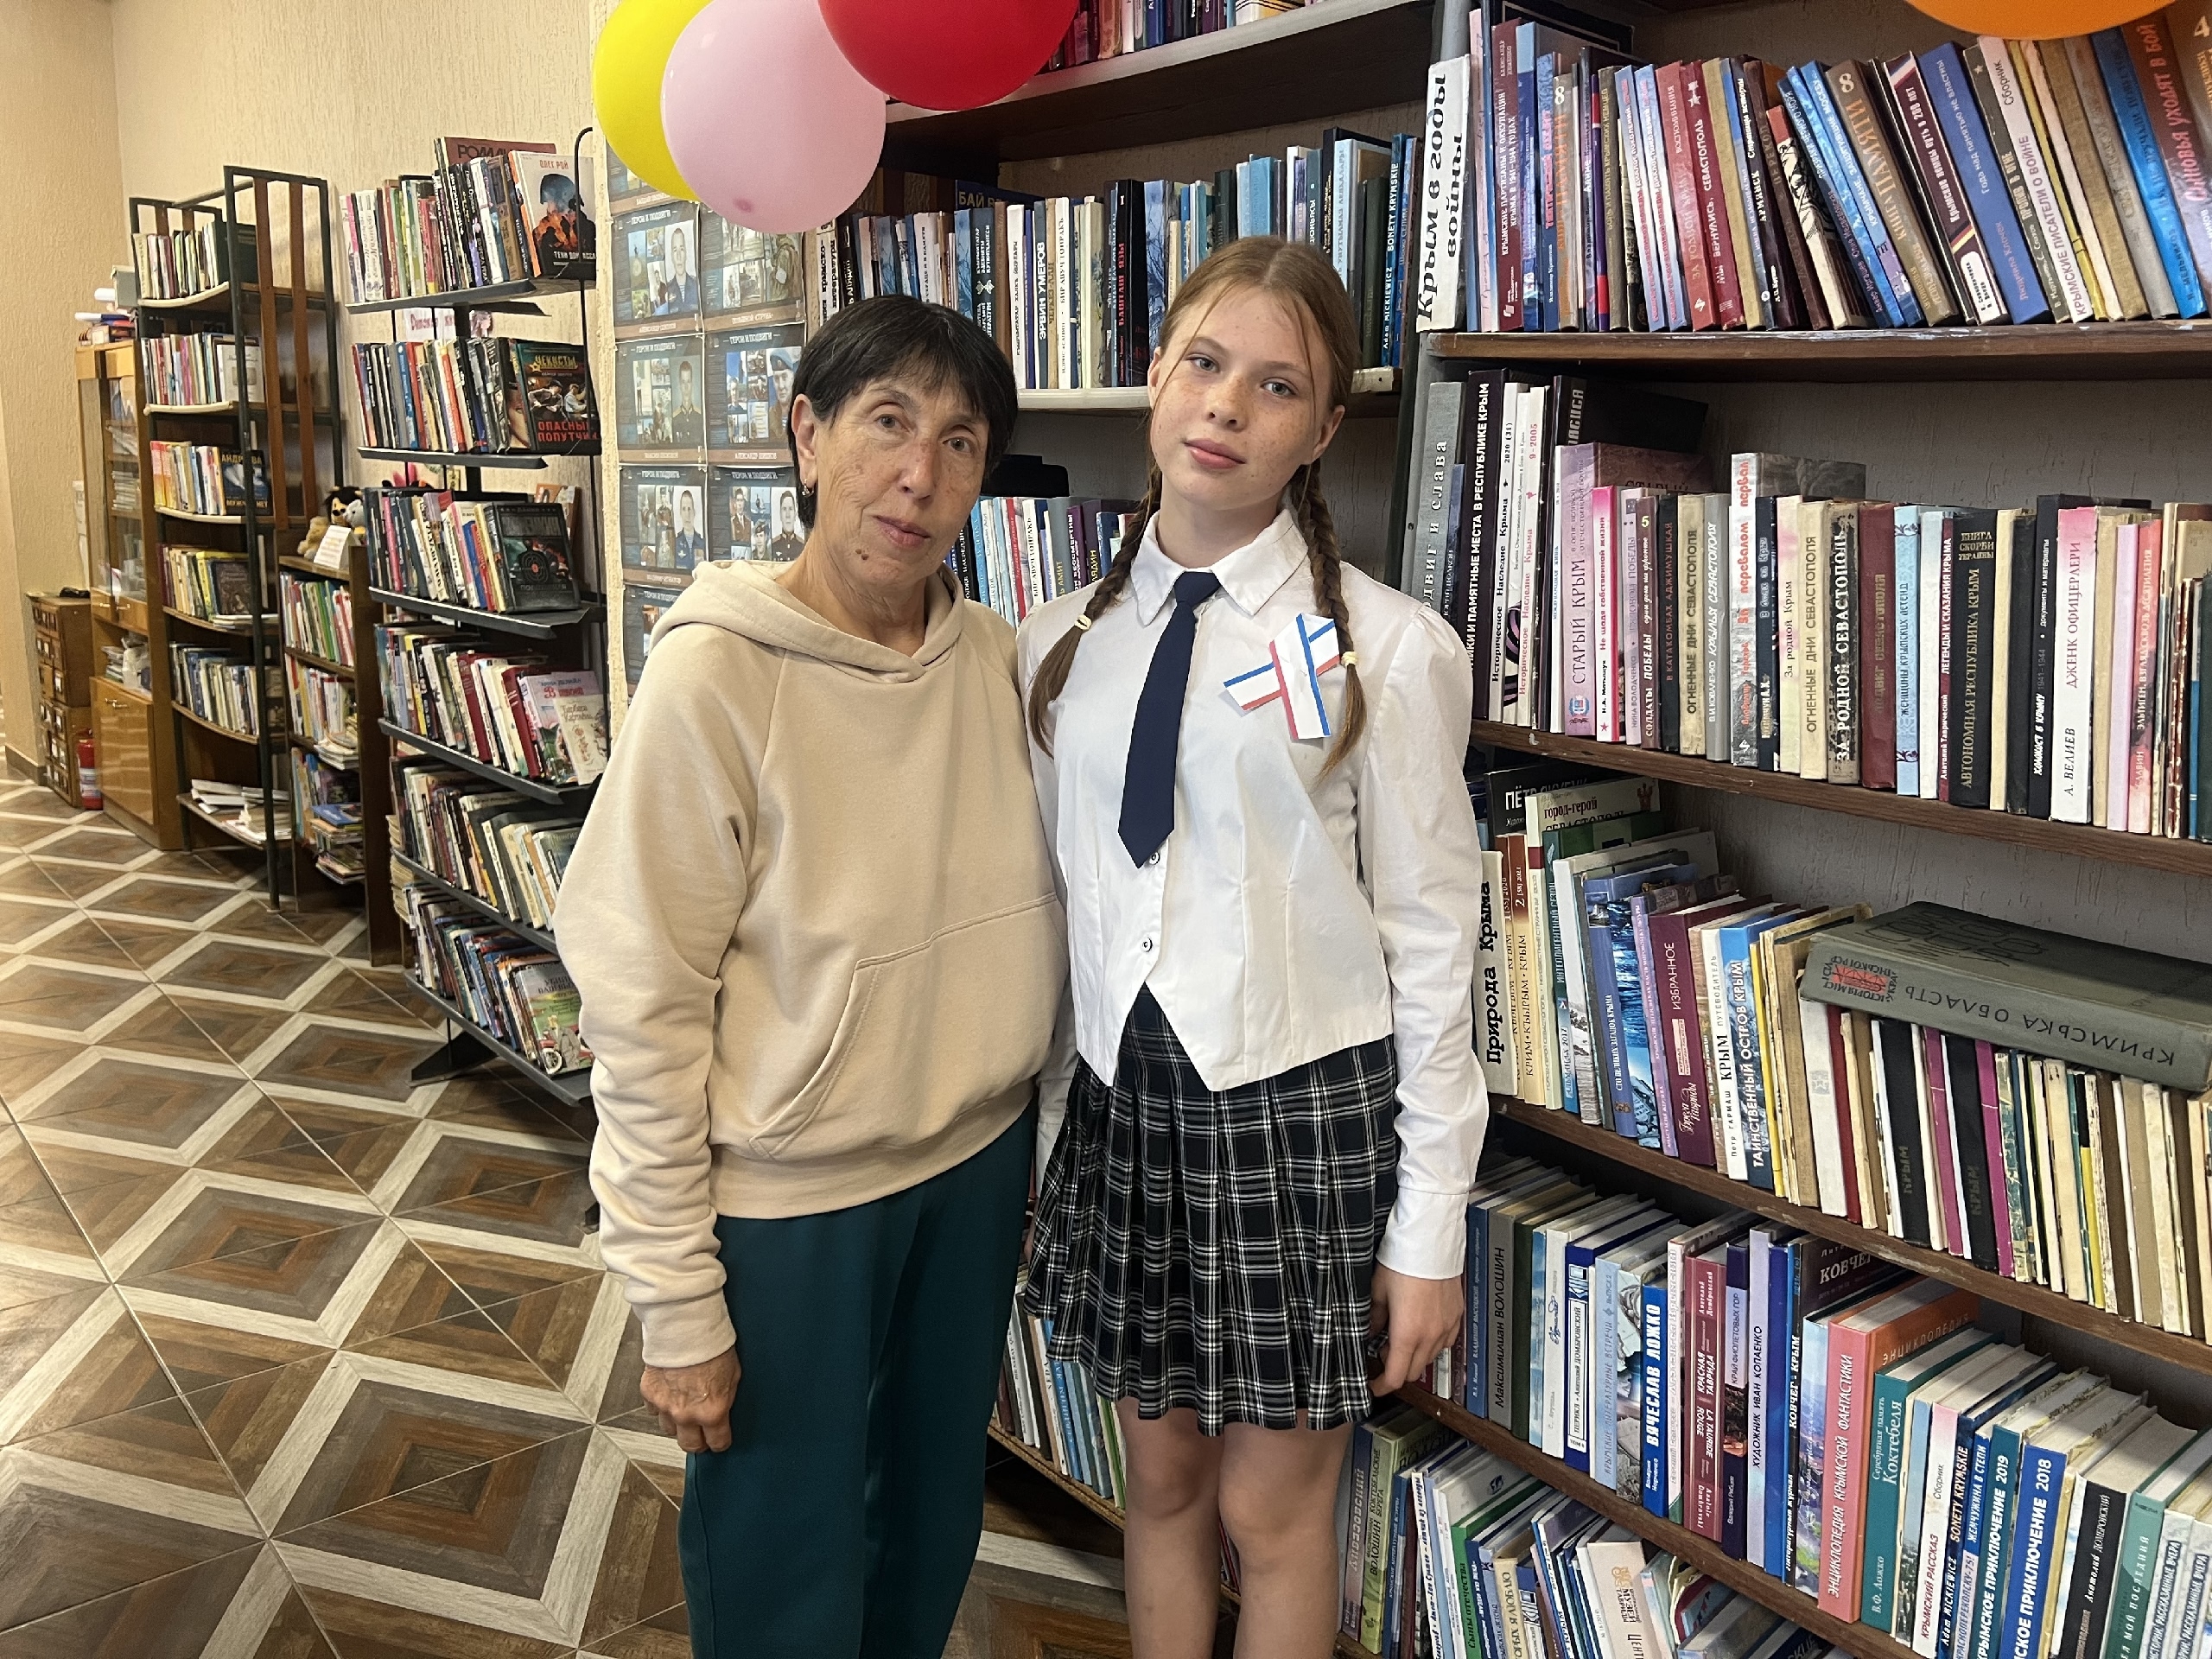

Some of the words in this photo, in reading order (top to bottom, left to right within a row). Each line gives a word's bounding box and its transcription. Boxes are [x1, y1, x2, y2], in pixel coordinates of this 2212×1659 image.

[1736, 77, 1750, 113] истории
[1838, 72, 1854, 92] 8
[1936, 59, 1955, 98] властны
[1992, 59, 2015, 105] Сборник
[1423, 73, 1446, 169] годы
[1497, 92, 1506, 143] ОККУПАЦИЯ
[1949, 98, 1960, 110] не
[1694, 118, 1712, 191] СЕВАСТОПОЛЬ
[1741, 114, 1757, 158] Страницы
[1845, 99, 1894, 196] ПАМЯТИ
[1954, 110, 1976, 152] памятью
[2016, 135, 2039, 175] ВОЙНЕ
[556, 161, 568, 169] РОЙ
[1499, 155, 1508, 207] ПАРТИЗАНЫ
[1968, 152, 1981, 170] над
[1974, 169, 1991, 194] Года
[2031, 175, 2044, 188] О
[958, 190, 984, 207] БАЙ
[1389, 162, 1398, 210] KRYMSKIE
[1427, 179, 1440, 199] в
[1443, 132, 1462, 257] войны
[1750, 169, 1767, 222] АРМЯНСК
[1387, 214, 1395, 251] SONETY
[1500, 209, 1509, 255] КРЫМСКИЕ
[1704, 196, 1721, 257] ВЕРНУЛИСЬ,
[1881, 194, 1909, 241] КНИГА
[2035, 187, 2064, 250] ПИСАТЕЛИ
[1037, 241, 1046, 294] УМЕРОВ
[1416, 208, 1441, 321] Крым
[2055, 249, 2087, 316] КРЫМСКИЕ
[1383, 265, 1392, 321] MICKIEWICZ
[1038, 297, 1046, 340] ЭРВИН
[535, 355, 576, 366] ЧЕКИСТЫ
[537, 420, 588, 431] ОПАСНЫ
[1478, 383, 1489, 421] КРЫМ
[1431, 440, 1446, 510] слава
[1473, 422, 1487, 499] РЕСПУБЛИКЕ
[1430, 522, 1439, 533] и
[1471, 514, 1482, 553] МЕСТА
[1498, 498, 1509, 536] Крыма
[1961, 531, 1992, 541] КНИГА
[1495, 545, 1506, 595] Наследие
[1707, 522, 1716, 602] СЕВАСТОПОЛЯ
[1942, 537, 1951, 571] КРЫМА
[1958, 551, 1993, 560] УКРАИНЫ
[1959, 541, 1993, 551] СКОРБИ
[1467, 554, 1480, 621] ПАМЯТНЫЕ
[1571, 559, 1585, 607] КРЫМ
[1687, 530, 1697, 617] СЕВАСТОПОЛЯ
[1783, 581, 1793, 612] Крым
[1833, 531, 1847, 653] СЕВАСТОПОЛЬ
[1942, 574, 1951, 621] СКАЗАНИЯ
[1967, 569, 1980, 607] КРЫМ
[2067, 542, 2082, 633] ОФИЦЕРЛЕРИ
[1491, 606, 1503, 682] Историческое
[1571, 618, 1585, 683] СТАРЫЙ
[1687, 624, 1697, 648] ДНИ
[1707, 607, 1717, 655] КРЫЛЬЯ
[1784, 620, 1794, 659] родной
[1941, 632, 1950, 673] ЛЕГЕНДЫ
[1965, 612, 1979, 696] РЕСПУБЛИКА
[1643, 633, 1652, 680] ПОБЕДЫ
[1784, 665, 1792, 677] За
[2066, 639, 2078, 688] ДЖЕНК
[1687, 654, 1697, 713] ОГНЕННЫЕ
[1834, 664, 1850, 729] РОДНОЙ
[1644, 687, 1653, 736] СОЛДАТЫ
[1940, 694, 1948, 742] Таврический
[1835, 740, 1849, 760] ЗА
[1939, 743, 1948, 779] Анатолий
[1960, 699, 1975, 787] АВТОНОМНАЯ
[2063, 728, 2075, 779] ВЕЛИЕВ
[1542, 797, 1598, 821] город-герой
[2063, 784, 2074, 795] А.
[1476, 880, 1498, 952] Крыма
[1664, 941, 1681, 1010] ИЗБРАННОЕ
[1709, 955, 1723, 1026] ПУТЕВОДИТЕЛЬ
[1730, 962, 1745, 1002] КРЫМ
[1482, 966, 1504, 1065] Природа
[1903, 983, 2010, 1024] ОБЛАСТЬ
[1735, 1005, 1752, 1059] ОСТРОВ
[2019, 1013, 2175, 1066] КРИМСЬКА
[1716, 1033, 1732, 1080] КРЫМ
[1724, 1090, 1734, 1128] ГАРМАШ
[1739, 1063, 1764, 1167] ТАИНСТВЕННЫЙ
[1729, 1135, 1738, 1156] Петр
[1494, 1248, 1504, 1318] ВОЛОШИН
[1573, 1306, 1581, 1364] ДОМБРОВСКИЙ
[1646, 1304, 1660, 1360] ЛОЖКО
[1731, 1310, 1739, 1363] ФИОЛЕТОВЫХ
[1753, 1325, 1762, 1378] КОПАЕНКО
[1494, 1322, 1504, 1408] Максимилиан
[1696, 1351, 1705, 1393] КРАСНАЯ
[1706, 1355, 1715, 1395] ТАВРИДА
[1646, 1365, 1660, 1446] ВЯЧЕСЛАВ
[1706, 1409, 1713, 1421] LA
[1836, 1354, 1853, 1431] ФАНТАСТИКИ
[1877, 1396, 1885, 1427] память
[1752, 1413, 1761, 1467] ХУДОЖНИК
[1872, 1430, 1885, 1479] Серебряная
[1880, 1400, 1904, 1484] Коктебеля
[1369, 1448, 1380, 1513] КОКТЕБЕЛЬСКИЕ
[1830, 1436, 1848, 1500] КРЫМСКОЙ
[1932, 1463, 1945, 1499] Сборник
[1953, 1446, 1968, 1499] KRYMSKIE
[1347, 1468, 1364, 1571] АЙВАЗОВСКИЙ
[1374, 1488, 1384, 1516] БЕРЕГА
[1949, 1499, 1963, 1541] SONETY
[1982, 1488, 2006, 1590] ПРИКЛЮЧЕНИЕ
[1994, 1454, 2009, 1484] 2019
[2091, 1493, 2110, 1552] ДОМБРОВСКИЙ
[1369, 1519, 1381, 1575] ВОЛОШИН
[1827, 1505, 1846, 1598] ЭНЦИКЛОПЕДИЯ
[1925, 1533, 1939, 1580] РАССКАЗ
[1458, 1562, 1471, 1615] отечества
[1872, 1555, 1884, 1590] Ложко
[1942, 1555, 1957, 1617] MICKIEWICZ
[2083, 1553, 2100, 1603] Анатолий
[1464, 1617, 1476, 1649] Сыны
[1919, 1580, 1934, 1638] КРЫМСКИЙ
[1941, 1620, 1951, 1646] Adam
